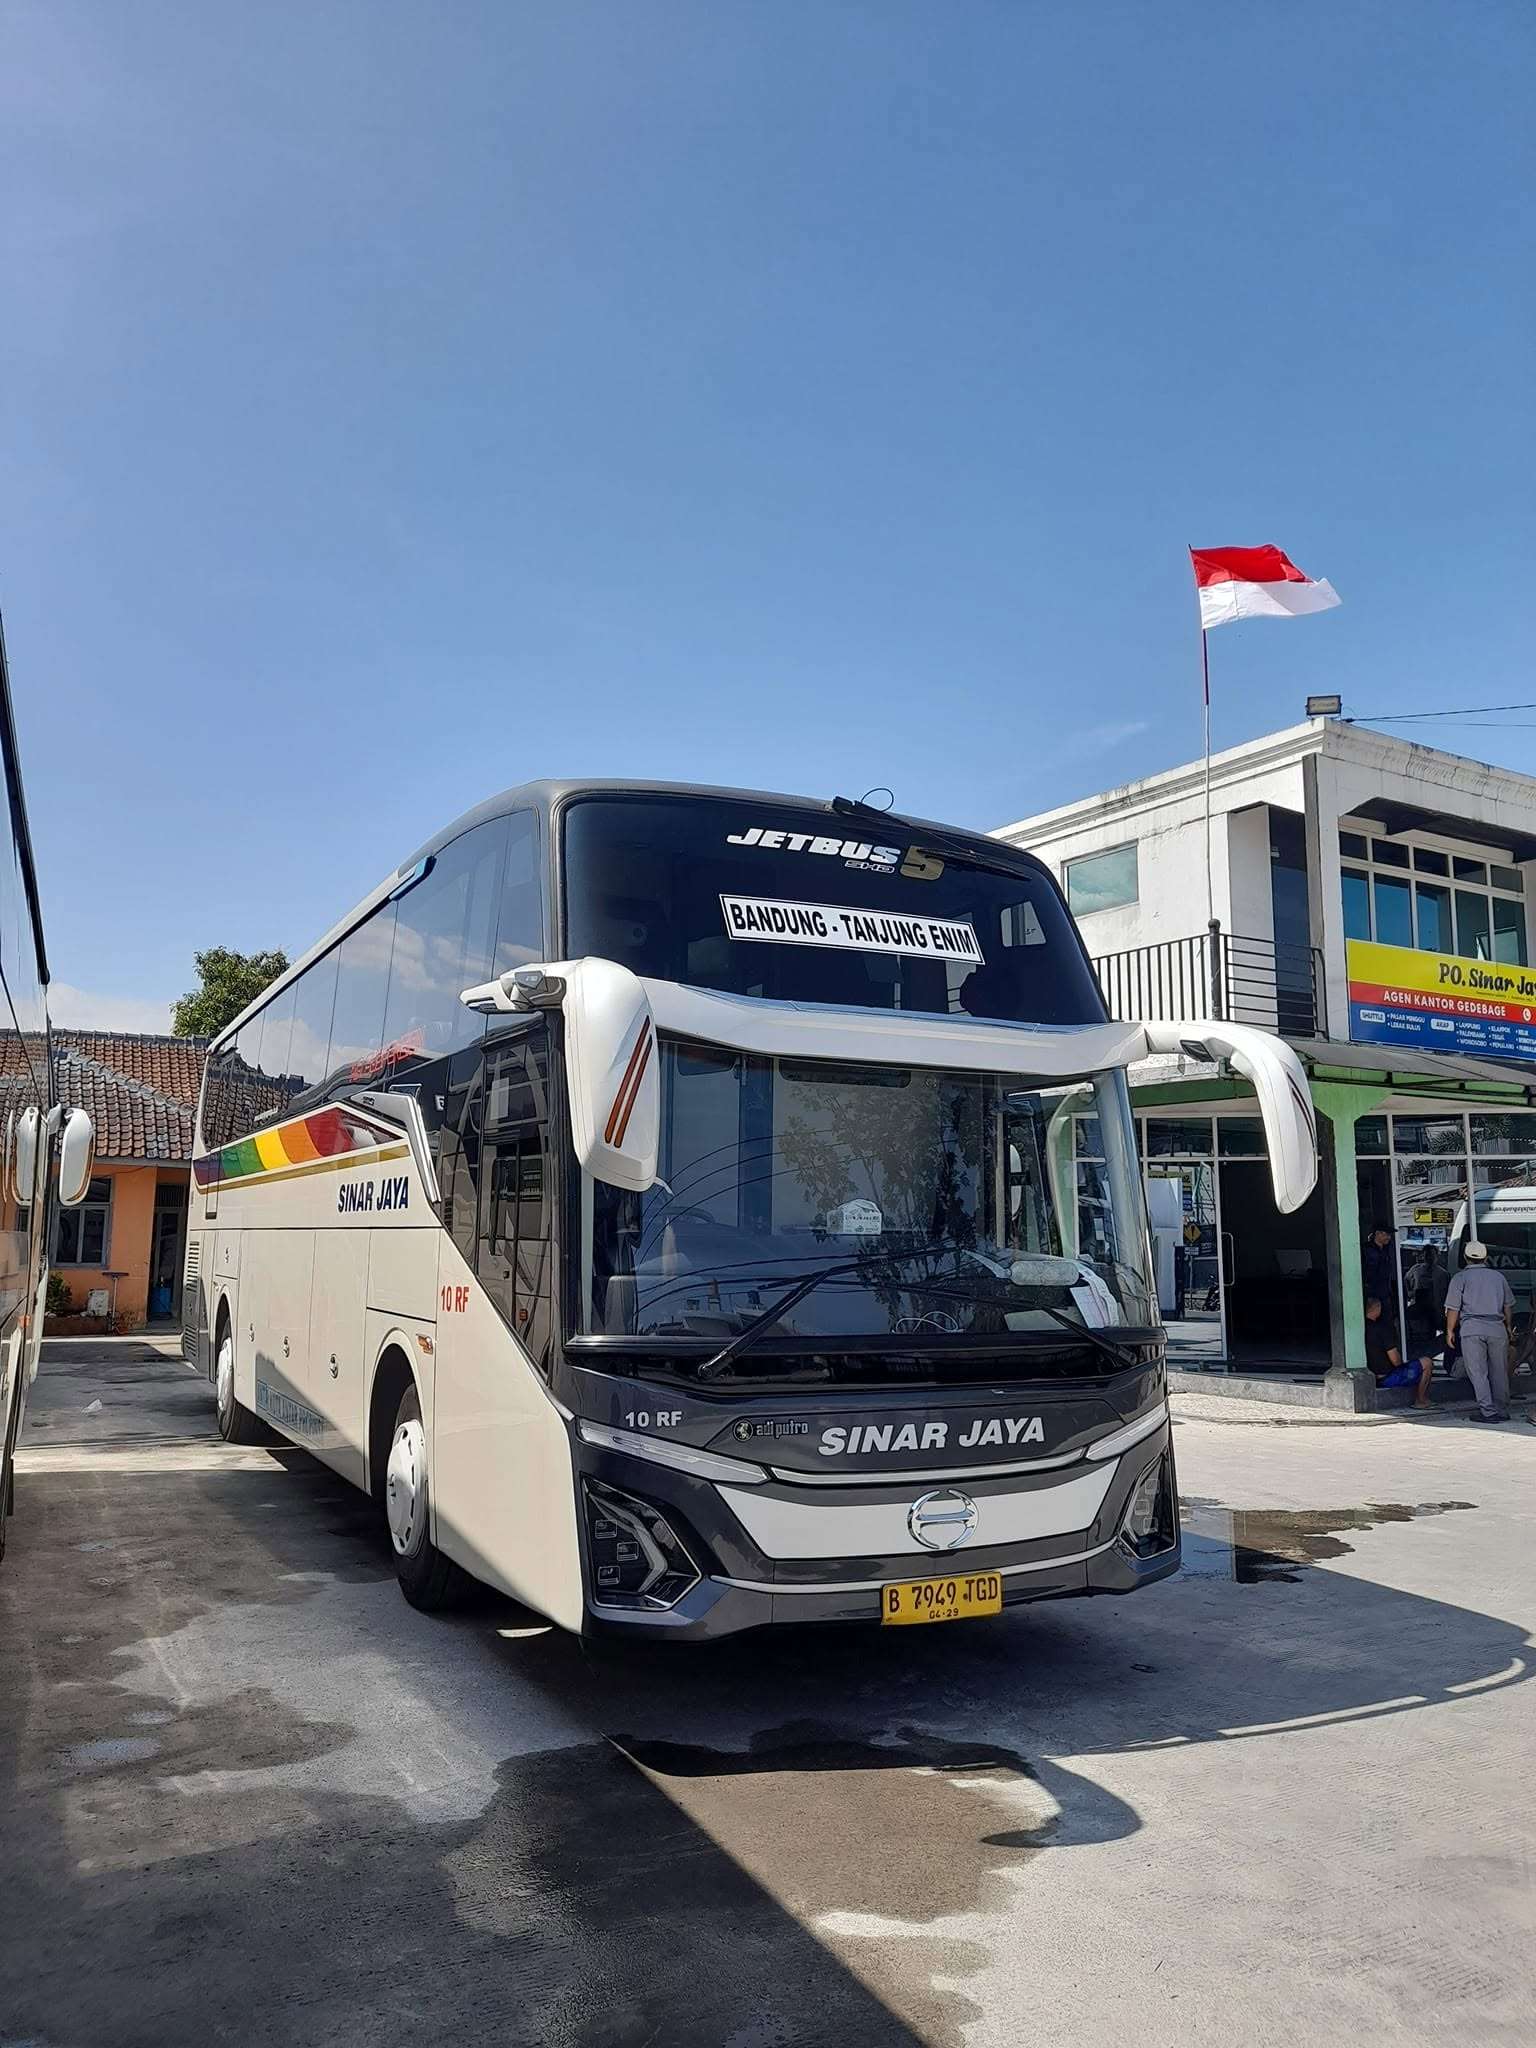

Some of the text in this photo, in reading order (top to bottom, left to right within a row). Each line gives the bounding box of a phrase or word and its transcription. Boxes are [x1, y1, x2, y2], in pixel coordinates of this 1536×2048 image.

[726, 828, 945, 881] JETBUS 5
[729, 903, 828, 938] BANDUNG
[839, 914, 928, 949] TANJUNG
[928, 924, 976, 955] ENIM
[1439, 963, 1466, 986] PO.
[1469, 968, 1515, 992] Sinar
[1383, 990, 1506, 1017] AGEN KANTOR GEDEBAGE
[338, 1176, 409, 1213] SINAR JAYA
[441, 1285, 470, 1313] 10 RF
[625, 1411, 682, 1428] 10 RF
[775, 1420, 809, 1439] putro
[818, 1416, 1045, 1456] SINAR JAYA
[889, 1577, 998, 1613] B 7949 TGD
